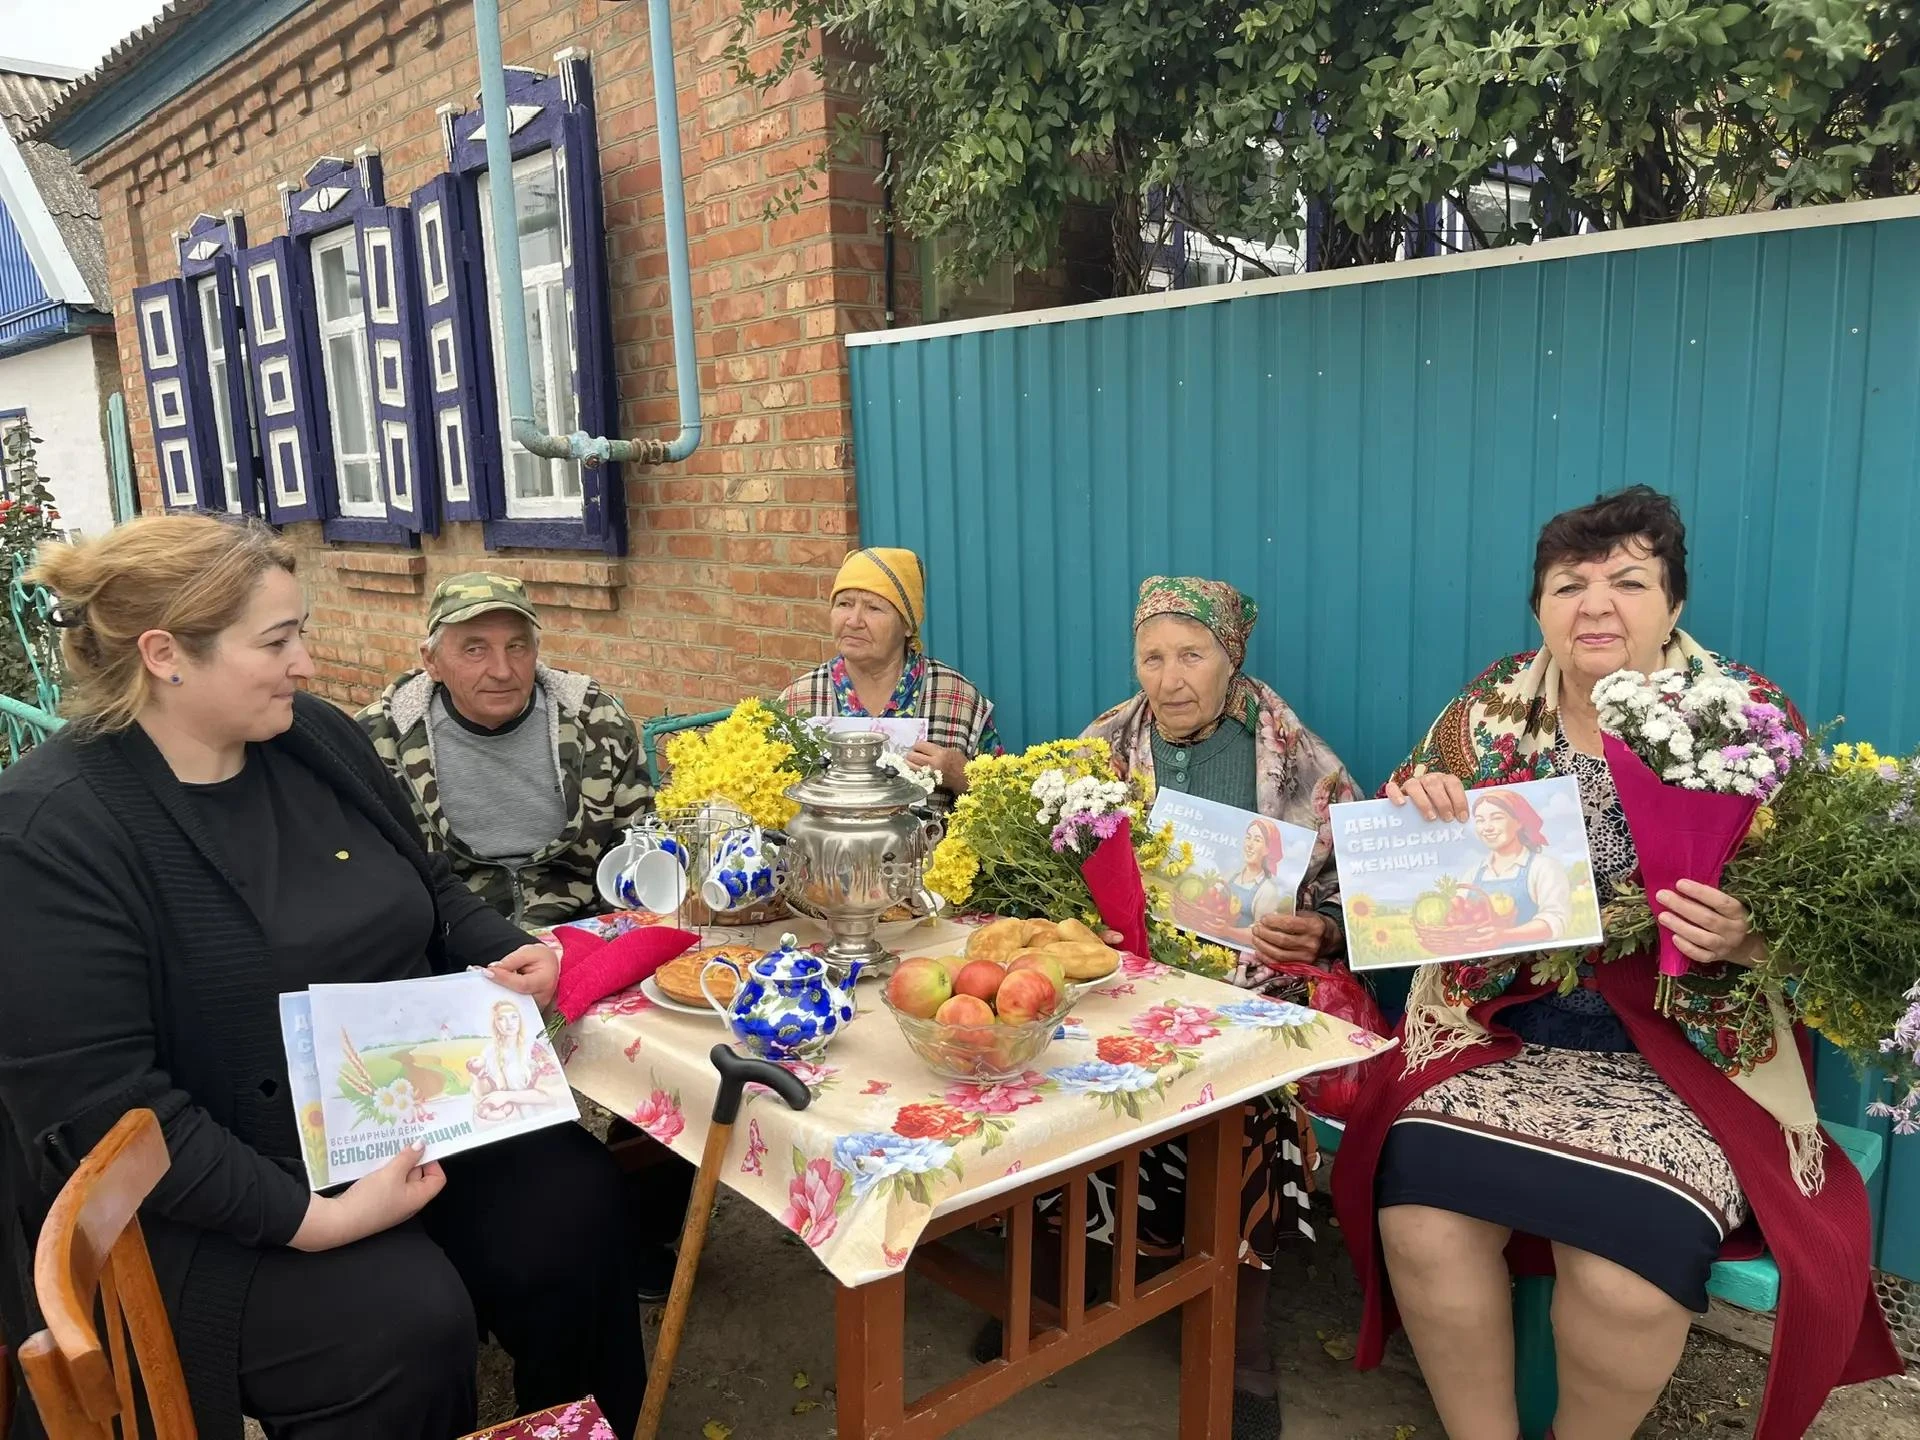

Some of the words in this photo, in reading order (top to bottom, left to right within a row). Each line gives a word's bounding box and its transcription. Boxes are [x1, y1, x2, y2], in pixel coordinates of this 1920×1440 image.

[1162, 802, 1204, 821] ДЕНЬ
[1160, 817, 1239, 848] ЕЛЬСКИХ
[1344, 815, 1403, 835] ДЕНЬ
[1347, 827, 1467, 853] СЕЛЬСКИХ
[1350, 850, 1440, 875] ЖЕНЩИН
[330, 1129, 396, 1147] ВСЕМИРНЫЙ
[398, 1124, 425, 1138] ДЕНЬ
[330, 1138, 401, 1167] СЕЛЬСКИХ
[403, 1121, 473, 1147] НЩИН
